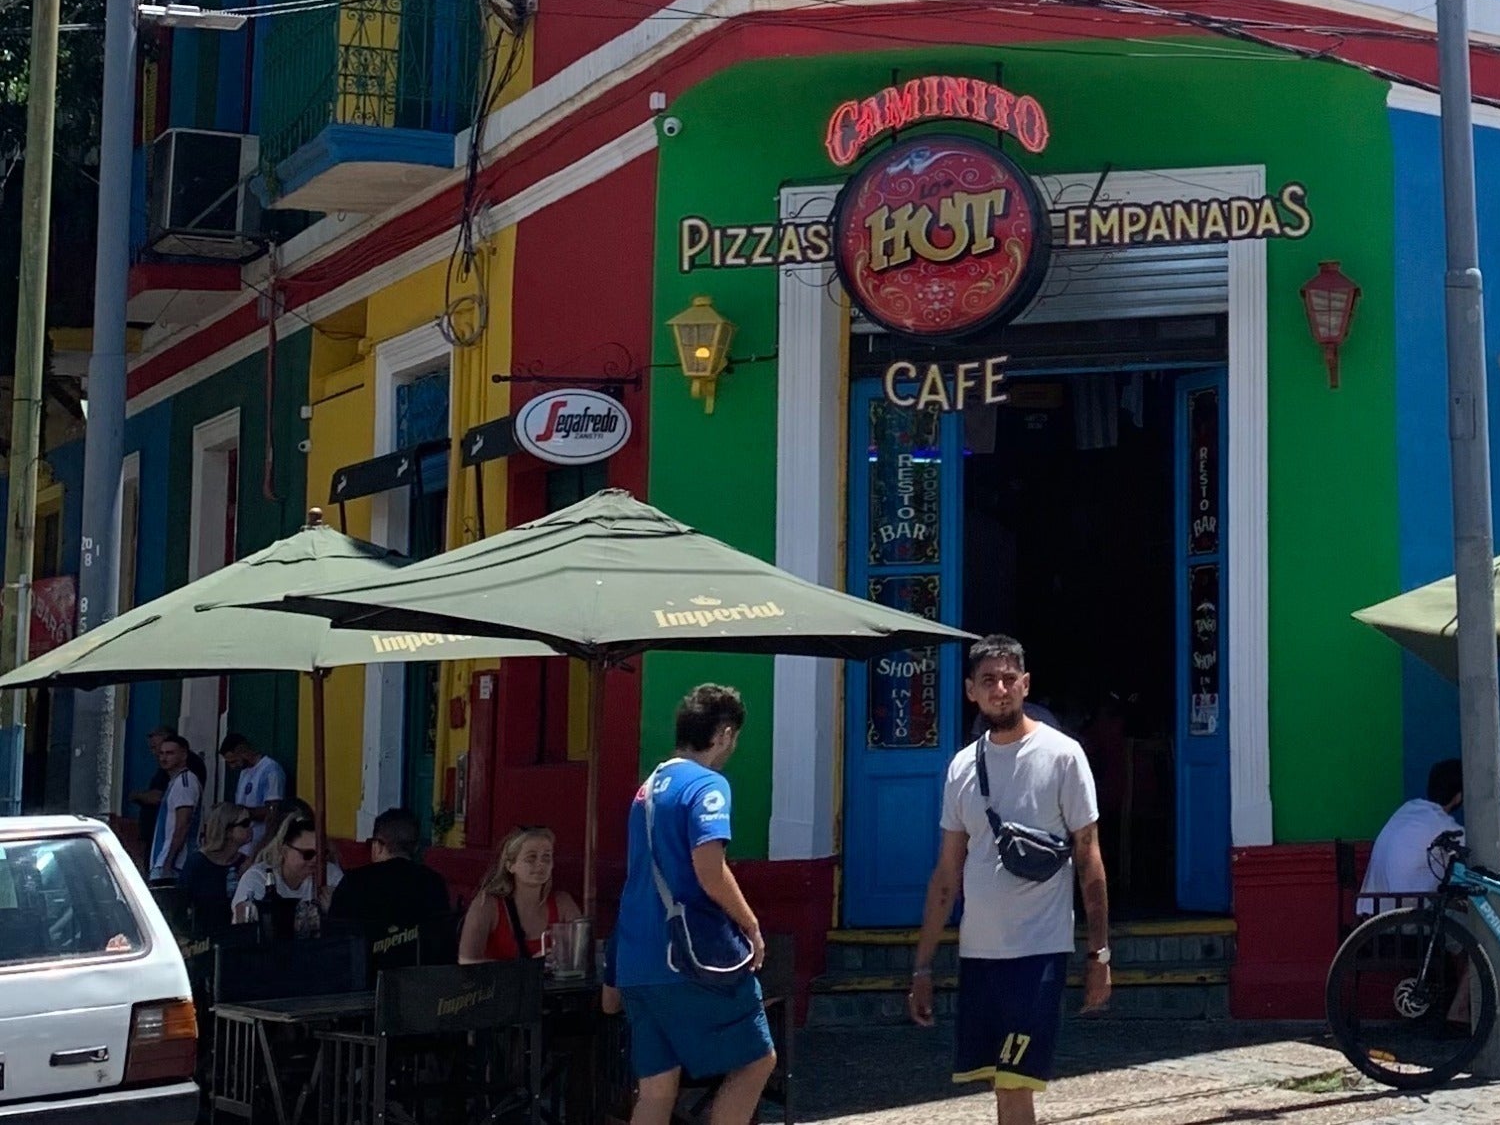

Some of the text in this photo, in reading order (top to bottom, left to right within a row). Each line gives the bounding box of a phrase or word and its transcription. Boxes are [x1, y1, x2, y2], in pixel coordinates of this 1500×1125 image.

[825, 75, 1049, 166] CAMINITO
[1067, 185, 1312, 248] EMPANADAS
[681, 218, 832, 271] PIZZAS
[884, 355, 1009, 411] CAFE
[535, 400, 619, 443] Segafredo
[897, 454, 915, 520] RESTO
[1199, 446, 1209, 512] RESTO
[879, 521, 926, 544] BAR
[1193, 515, 1217, 538] BAR
[652, 601, 785, 628] Imperial
[876, 658, 927, 678] SHOW
